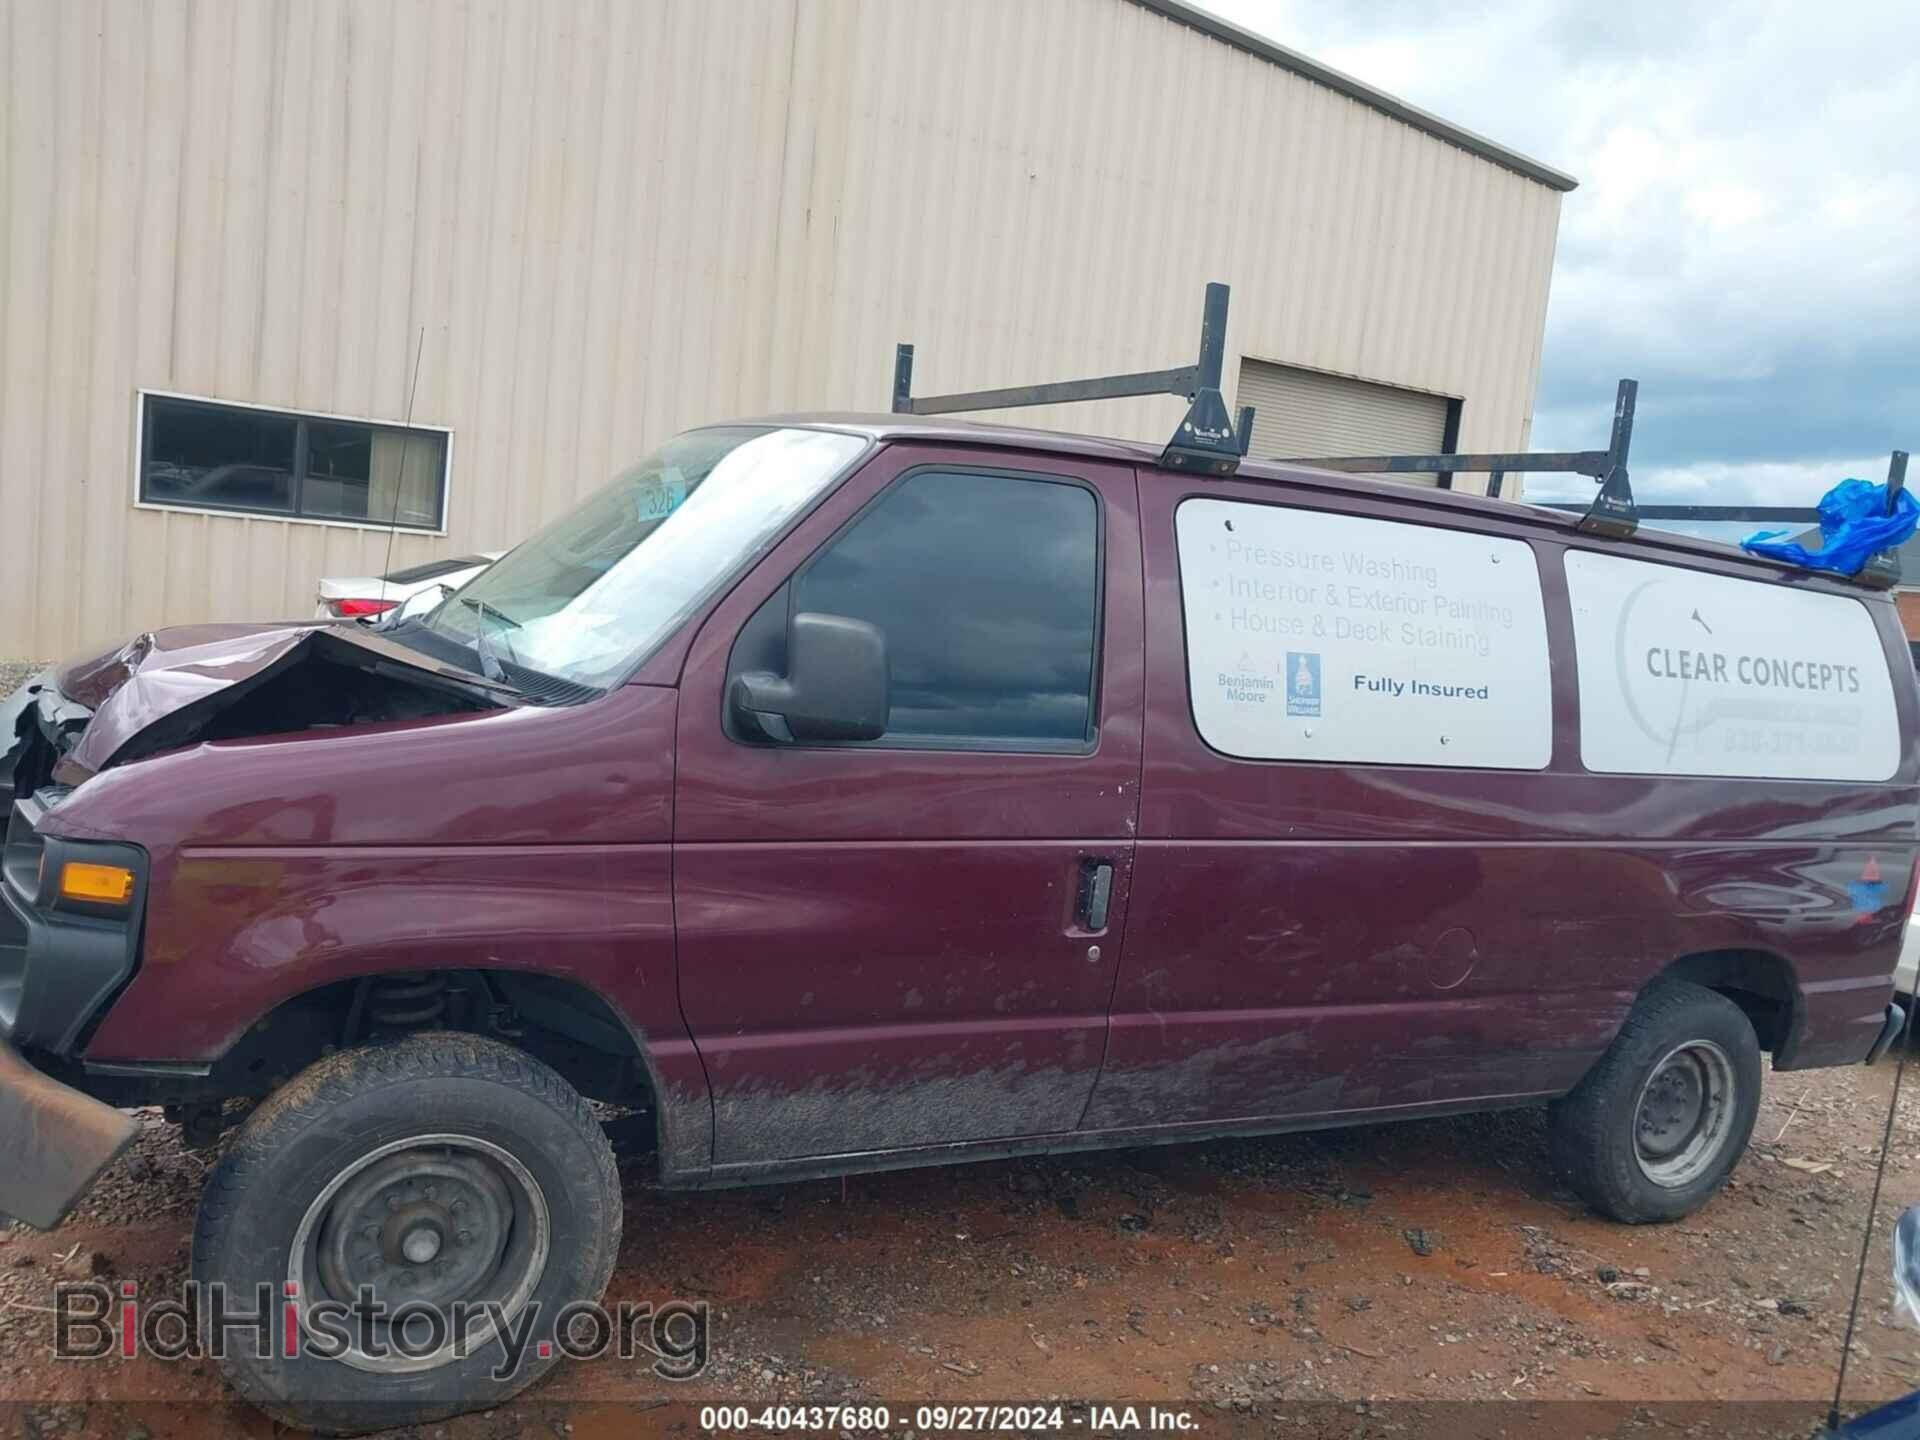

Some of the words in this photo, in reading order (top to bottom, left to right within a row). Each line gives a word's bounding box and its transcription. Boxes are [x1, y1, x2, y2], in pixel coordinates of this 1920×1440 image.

[1225, 538, 1335, 574] Pressure
[1342, 551, 1438, 589] Washing
[1227, 574, 1318, 605] Interior
[1327, 584, 1346, 606] &
[1348, 585, 1427, 616] Exterior
[1434, 595, 1513, 629] Painting
[1231, 608, 1304, 637] House
[1312, 613, 1328, 639] &
[1335, 616, 1392, 644] Deck
[1400, 622, 1490, 657] Staining
[1217, 673, 1274, 690] Benjamin
[1354, 674, 1404, 697] Fully
[1411, 679, 1489, 700] Insured
[1647, 647, 1728, 682] CLEAR
[1737, 656, 1860, 693] CONCEPTS
[1226, 687, 1266, 703] Moore
